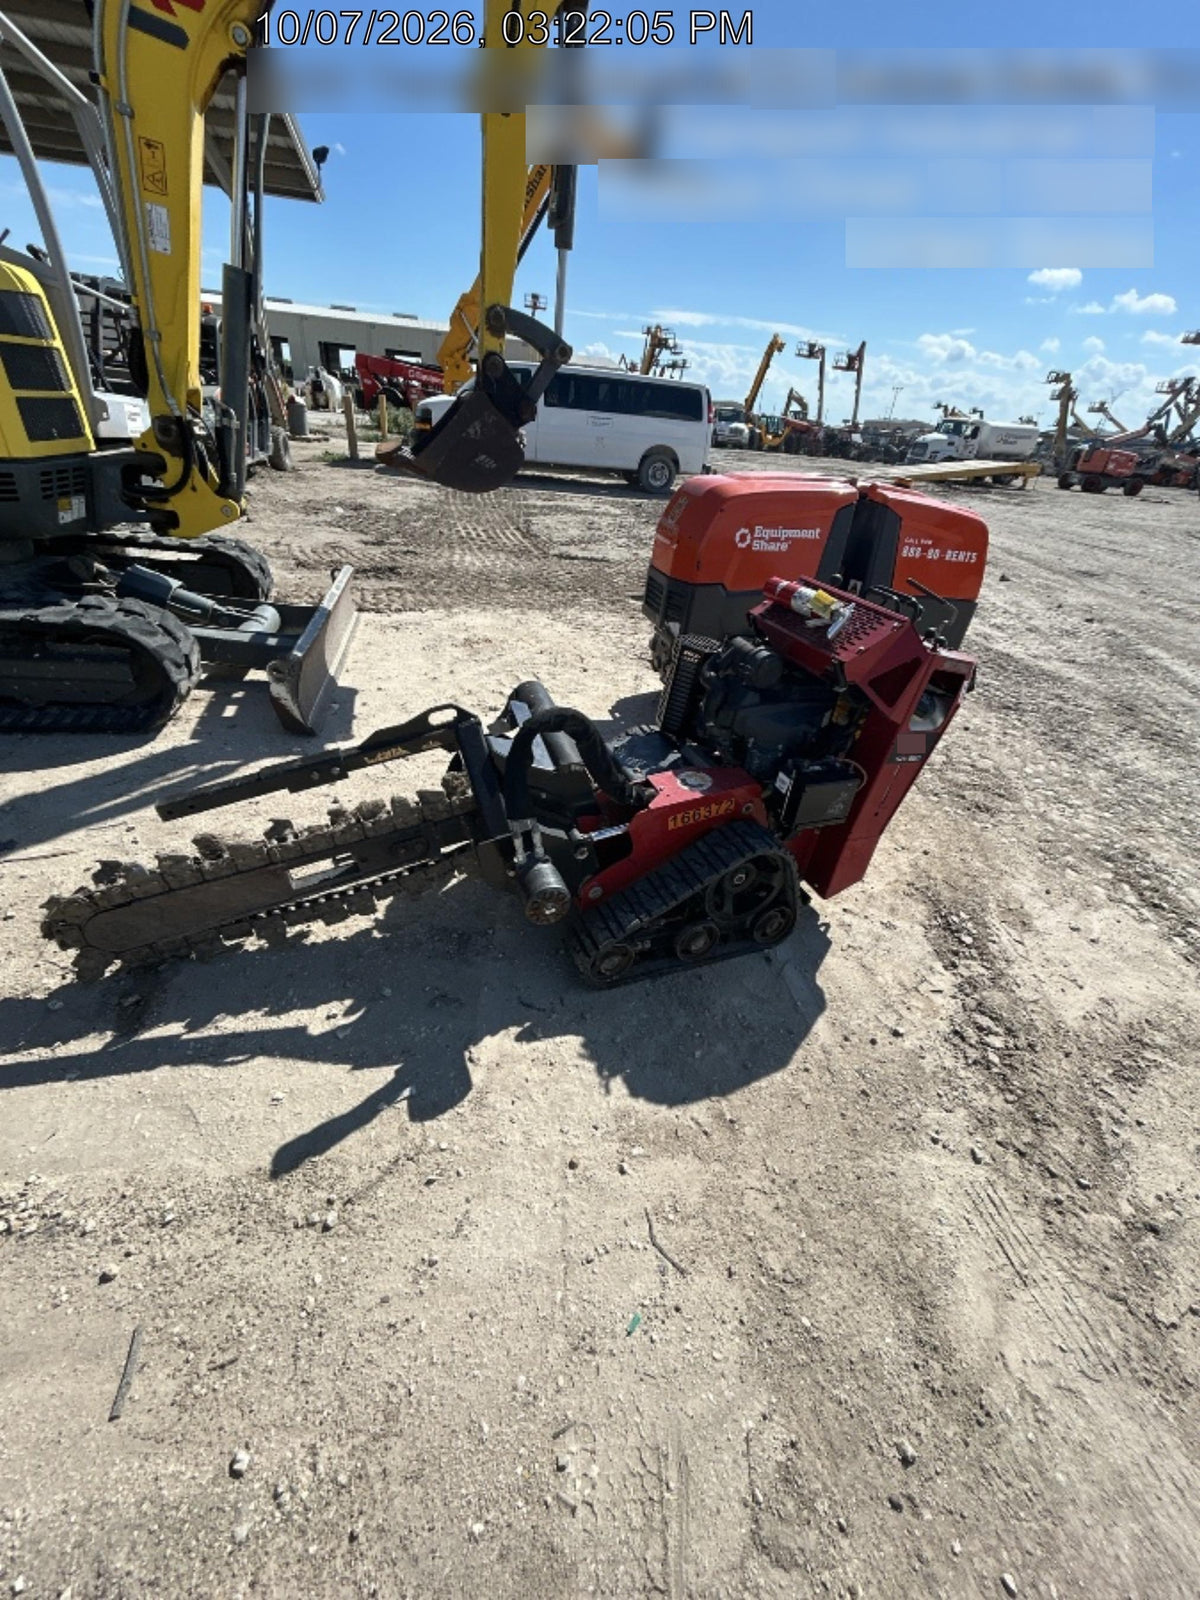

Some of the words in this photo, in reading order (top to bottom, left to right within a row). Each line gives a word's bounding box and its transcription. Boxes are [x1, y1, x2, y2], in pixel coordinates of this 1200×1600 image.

[753, 525, 821, 541] Equipment
[751, 540, 790, 552] Share
[667, 798, 736, 831] 166372
